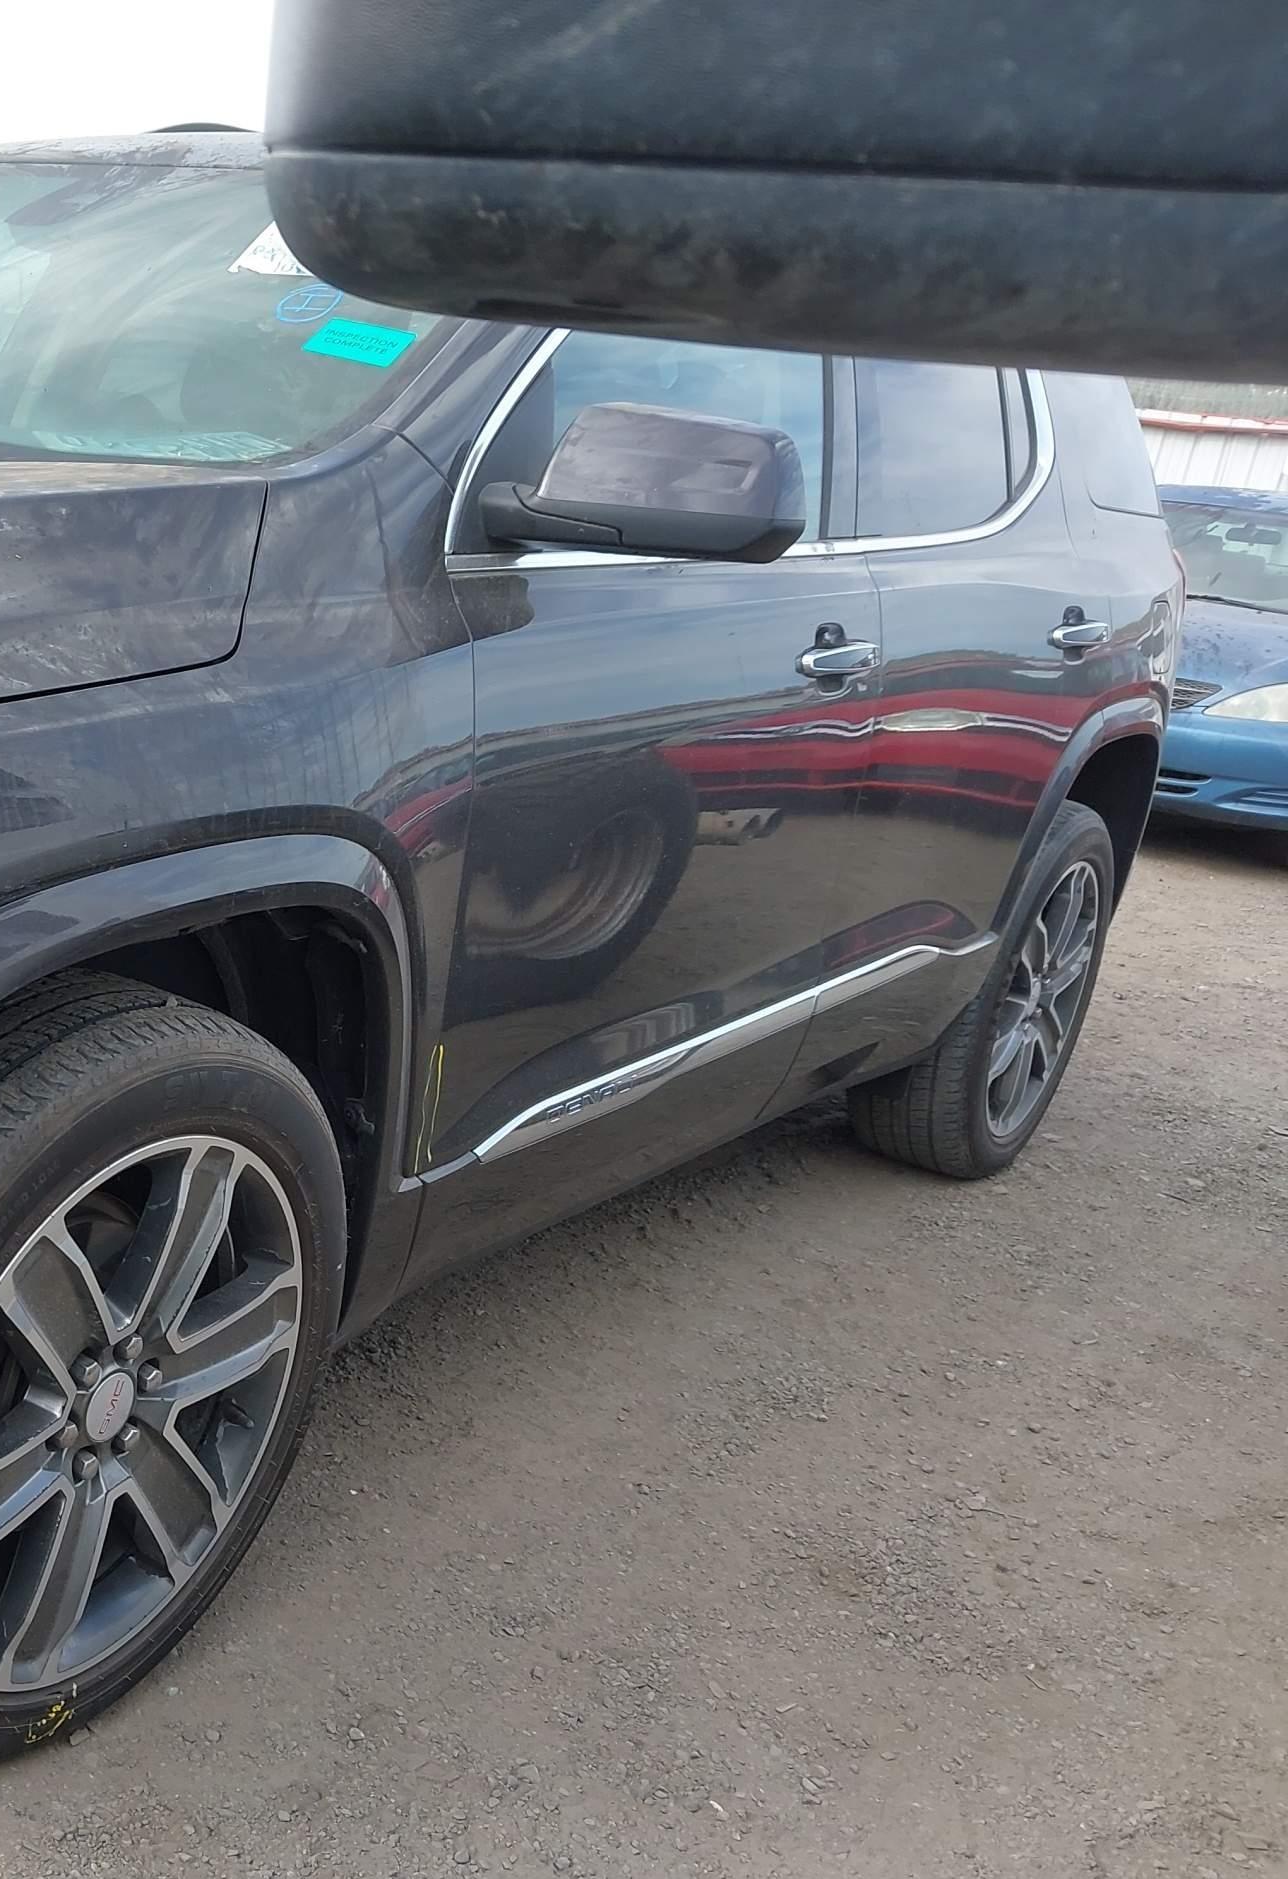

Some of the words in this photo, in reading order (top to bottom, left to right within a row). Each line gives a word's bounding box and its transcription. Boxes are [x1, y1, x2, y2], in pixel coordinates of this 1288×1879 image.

[324, 328, 400, 349] INSPECTION
[324, 337, 389, 355] COMPLETE
[546, 1073, 638, 1124] DENALI
[98, 1379, 125, 1435] GMC
